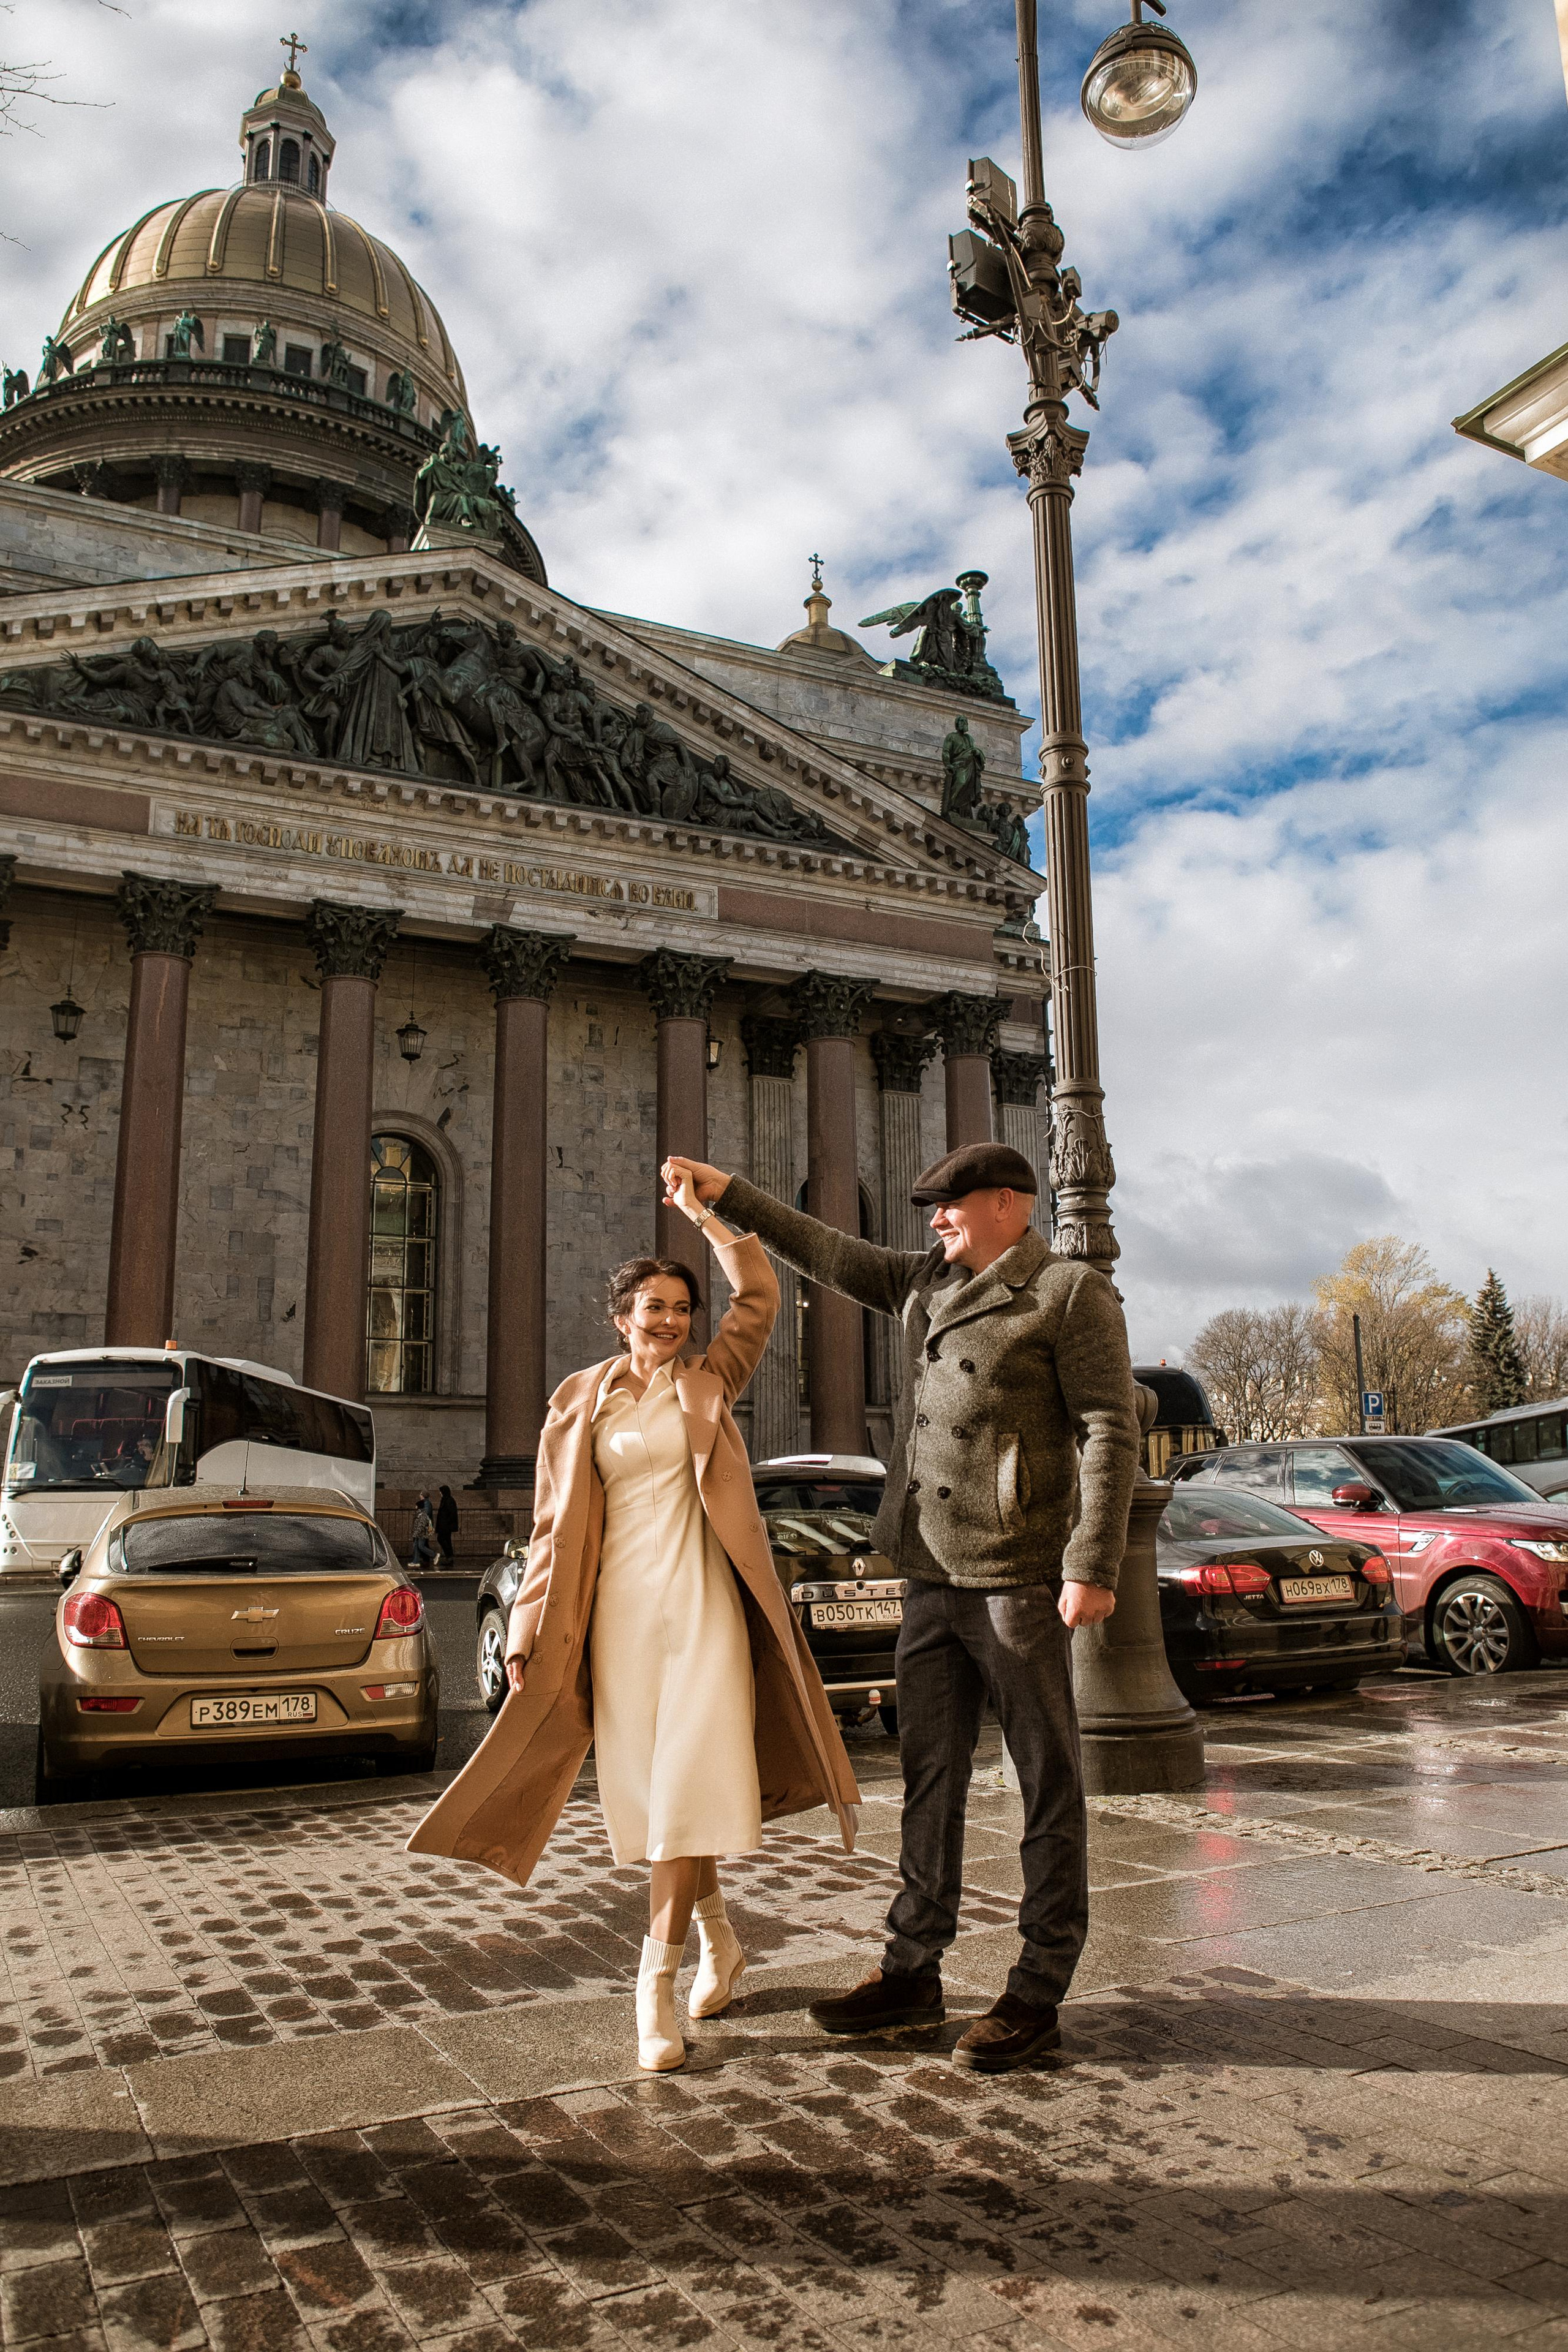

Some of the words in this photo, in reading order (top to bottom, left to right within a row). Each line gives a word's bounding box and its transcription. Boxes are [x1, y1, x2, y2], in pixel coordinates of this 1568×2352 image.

[1368, 1395, 1379, 1413] P
[1331, 1578, 1347, 1589] 178
[876, 1602, 897, 1615] 147
[282, 1696, 310, 1712] 178
